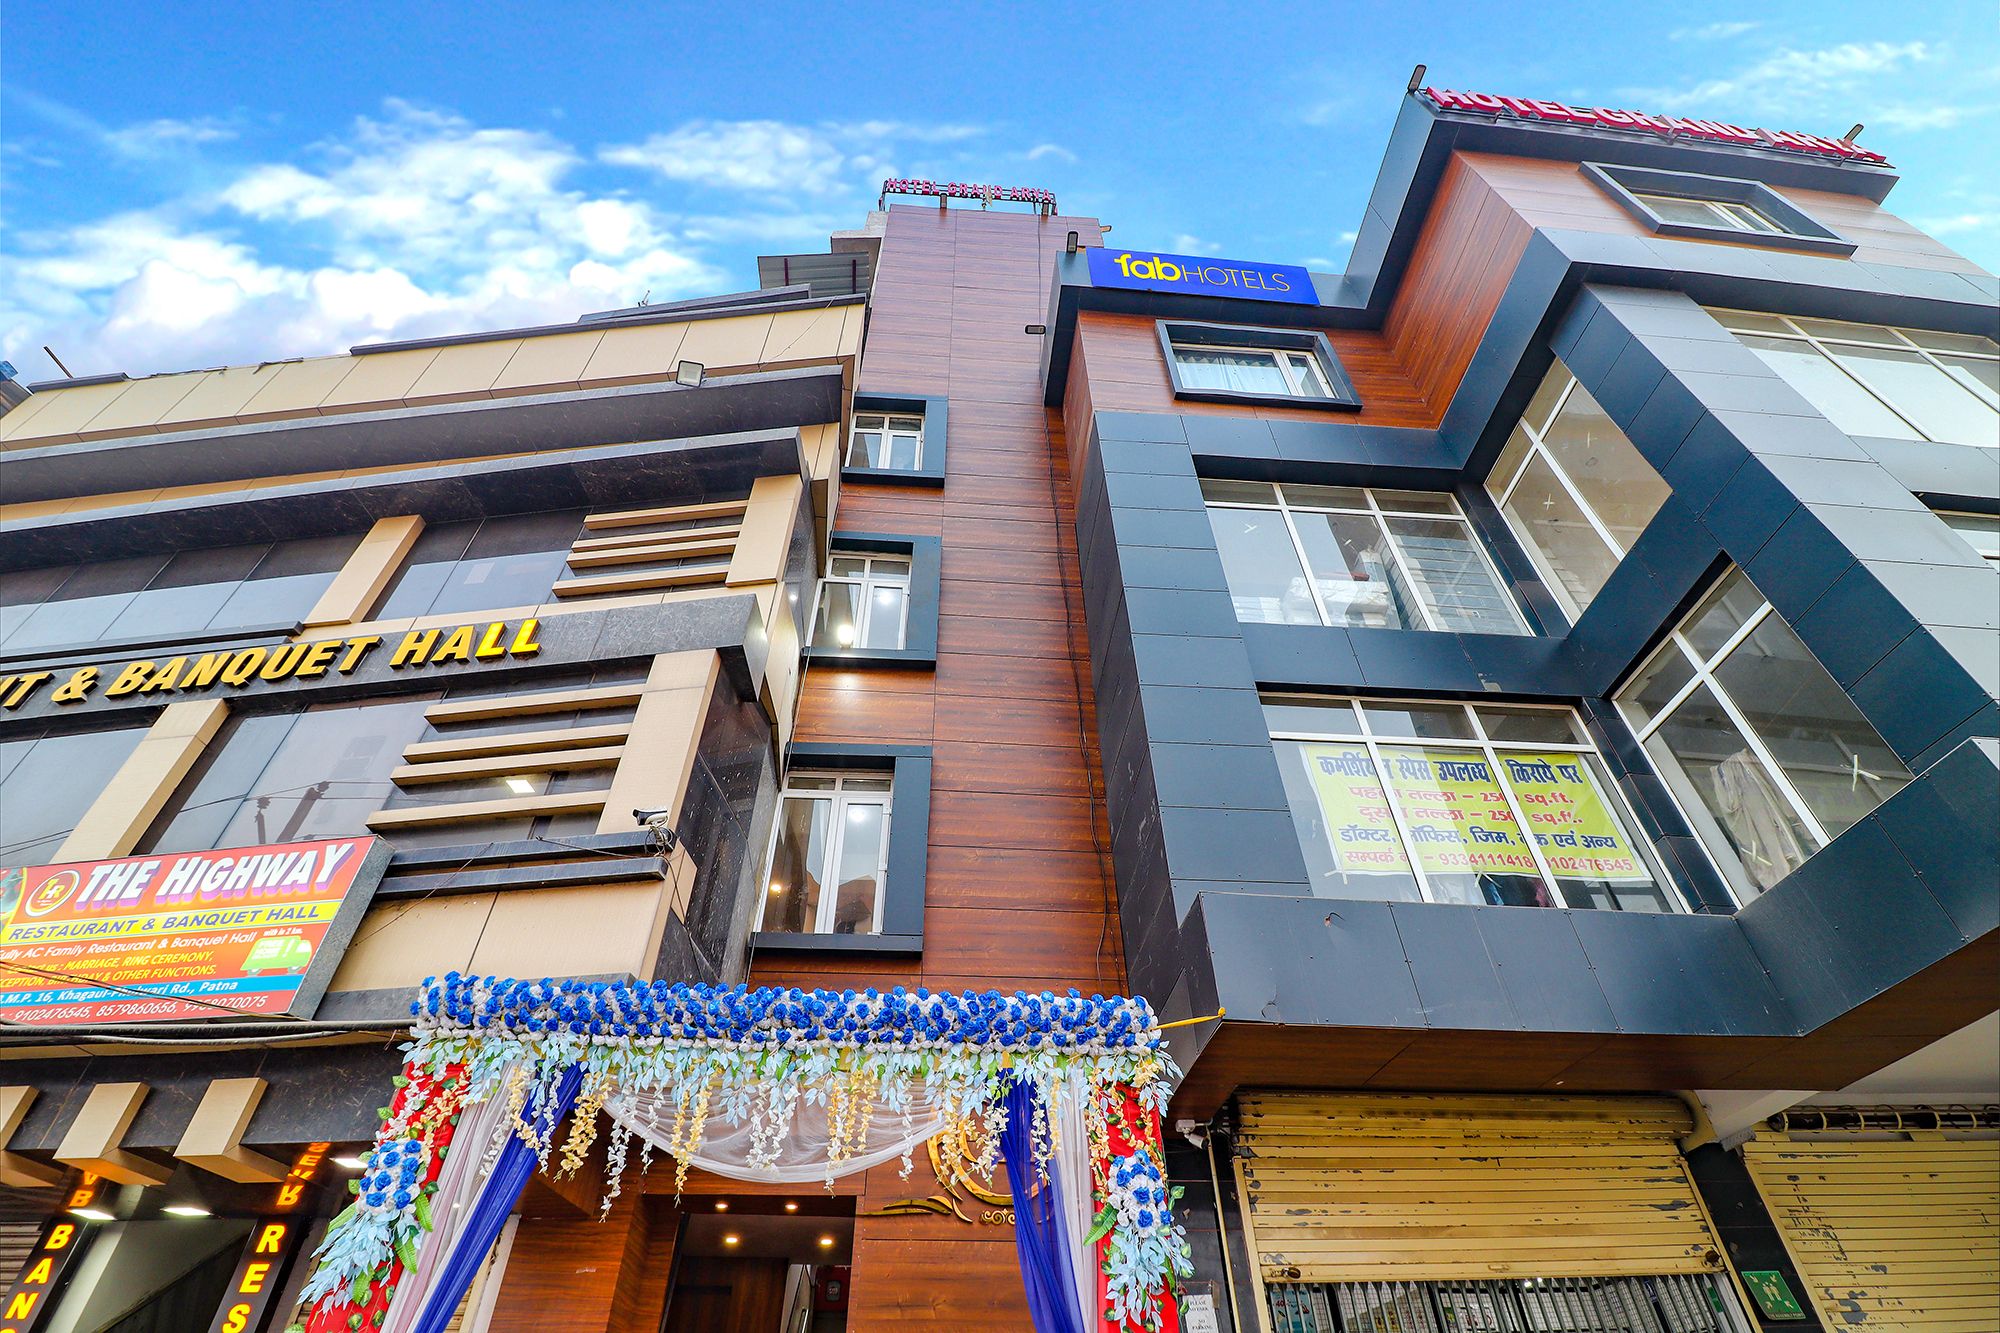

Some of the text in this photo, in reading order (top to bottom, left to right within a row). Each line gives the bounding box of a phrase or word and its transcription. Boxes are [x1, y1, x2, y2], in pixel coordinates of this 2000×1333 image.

[1426, 86, 1598, 126] HOTEL
[886, 178, 1052, 202] HOTEL GRAND ARYA
[51, 667, 100, 705] &
[104, 635, 385, 699] BANQUET
[389, 618, 543, 670] HALL
[1505, 758, 1559, 784] किराये
[1556, 764, 1584, 784] पर
[1405, 789, 1458, 802] तल्ला
[1524, 791, 1575, 807] sq.ft.
[1412, 807, 1465, 821] तल्ला
[1469, 826, 1516, 847] जिम,
[1550, 830, 1578, 849] एवं
[1580, 834, 1618, 849] अन्य
[77, 843, 356, 909] THE HIGHWAY
[8, 904, 320, 940] RESTAURANT & BANQUET HALL
[22, 946, 45, 959] AC
[44, 944, 86, 957] Family
[87, 939, 156, 955] Restaurant
[157, 938, 169, 949] &
[171, 933, 228, 949] Banquet
[228, 931, 258, 944] Hall
[64, 957, 120, 971] MARRIAGE,
[121, 955, 150, 967] RING
[150, 951, 214, 965] CEREMONY,
[103, 972, 112, 982] &
[112, 969, 149, 981] OTHER
[150, 964, 217, 979] FUNCTIONS.
[34, 992, 54, 1003] 16,
[169, 983, 195, 995] Rd.,
[198, 981, 239, 992] Patna
[0, 1224, 75, 1333] BAN
